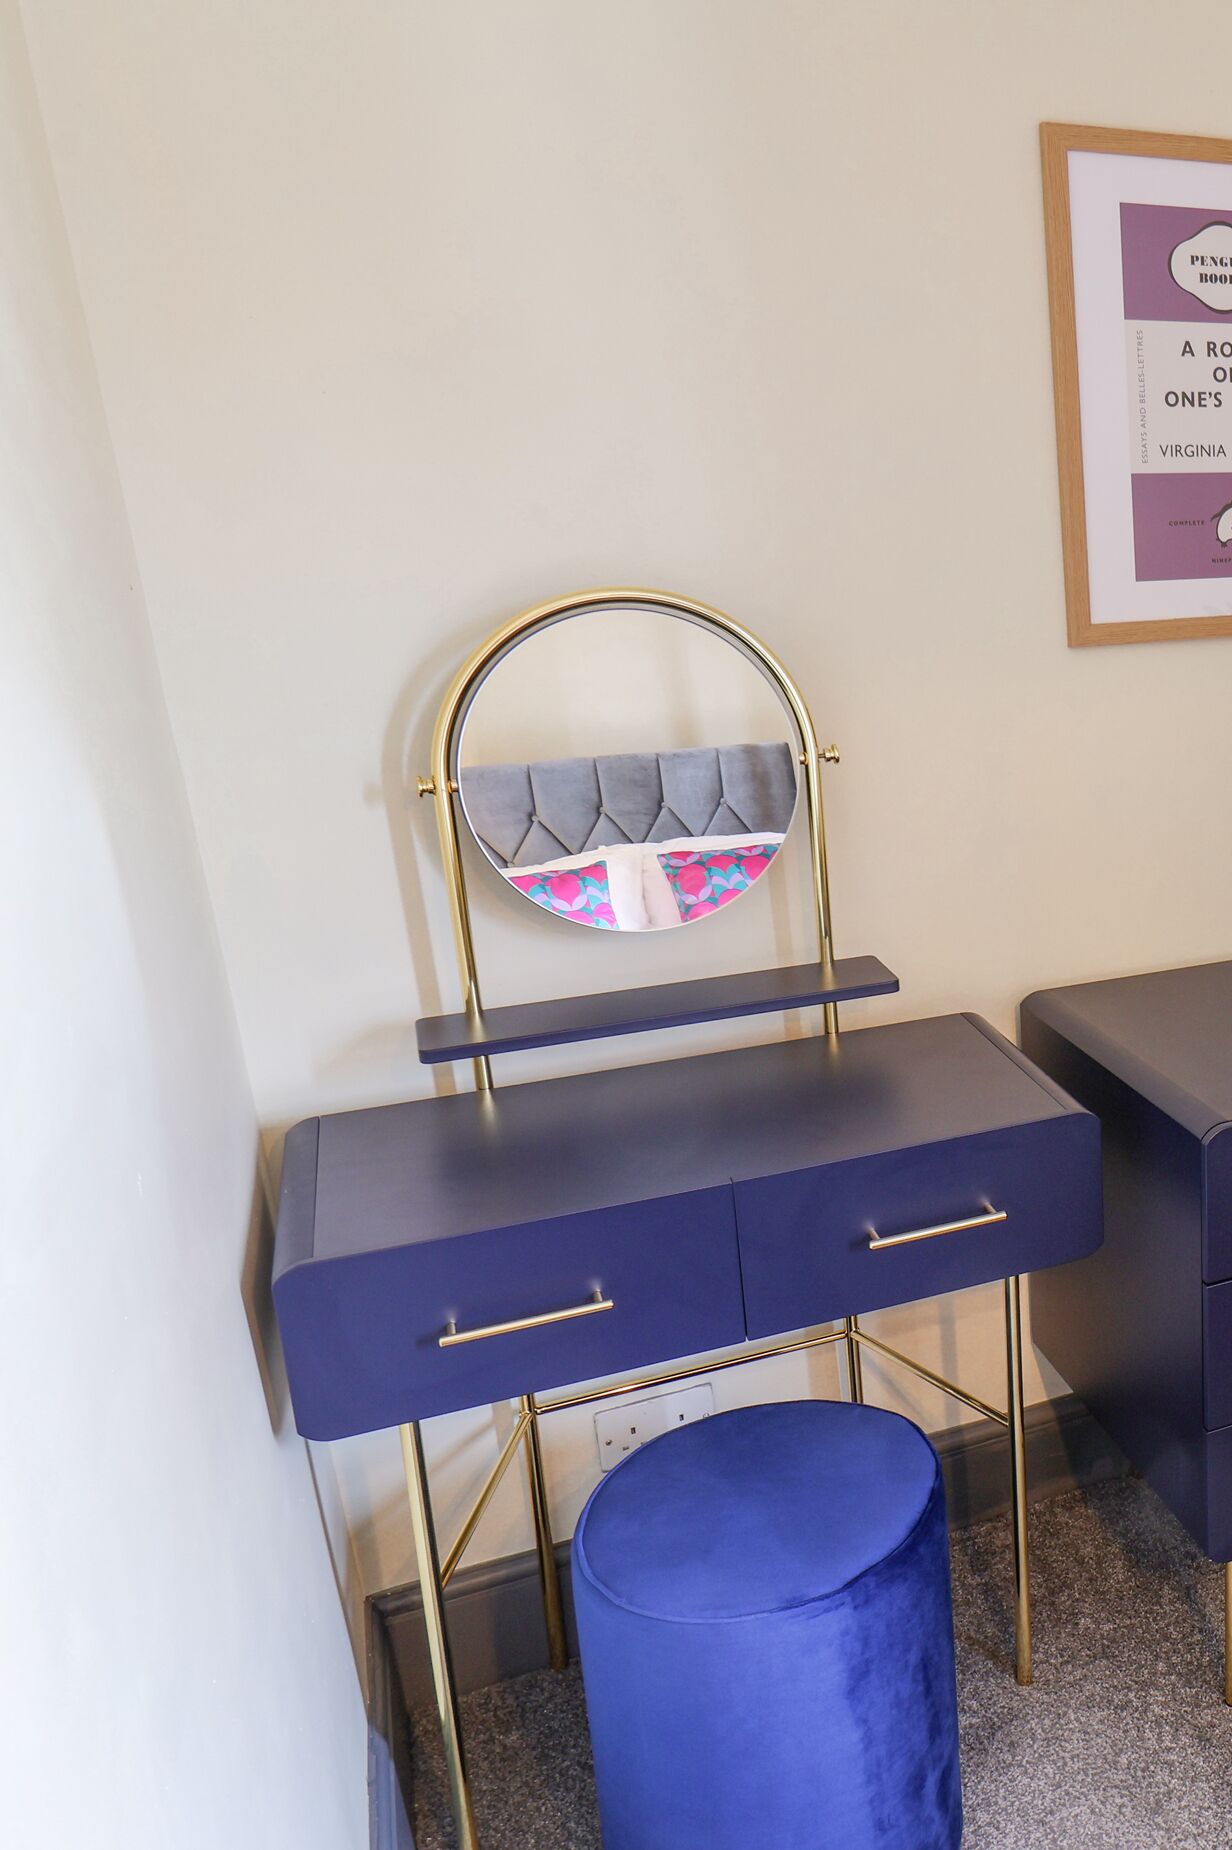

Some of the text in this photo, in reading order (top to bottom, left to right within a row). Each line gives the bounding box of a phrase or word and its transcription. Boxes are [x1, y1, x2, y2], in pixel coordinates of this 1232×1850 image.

[1181, 340, 1195, 357] A
[1136, 329, 1149, 464] ESSAYS AND BELLES-LETTRES
[1164, 391, 1223, 408] ONE'S
[1159, 444, 1227, 458] VIRGINIA
